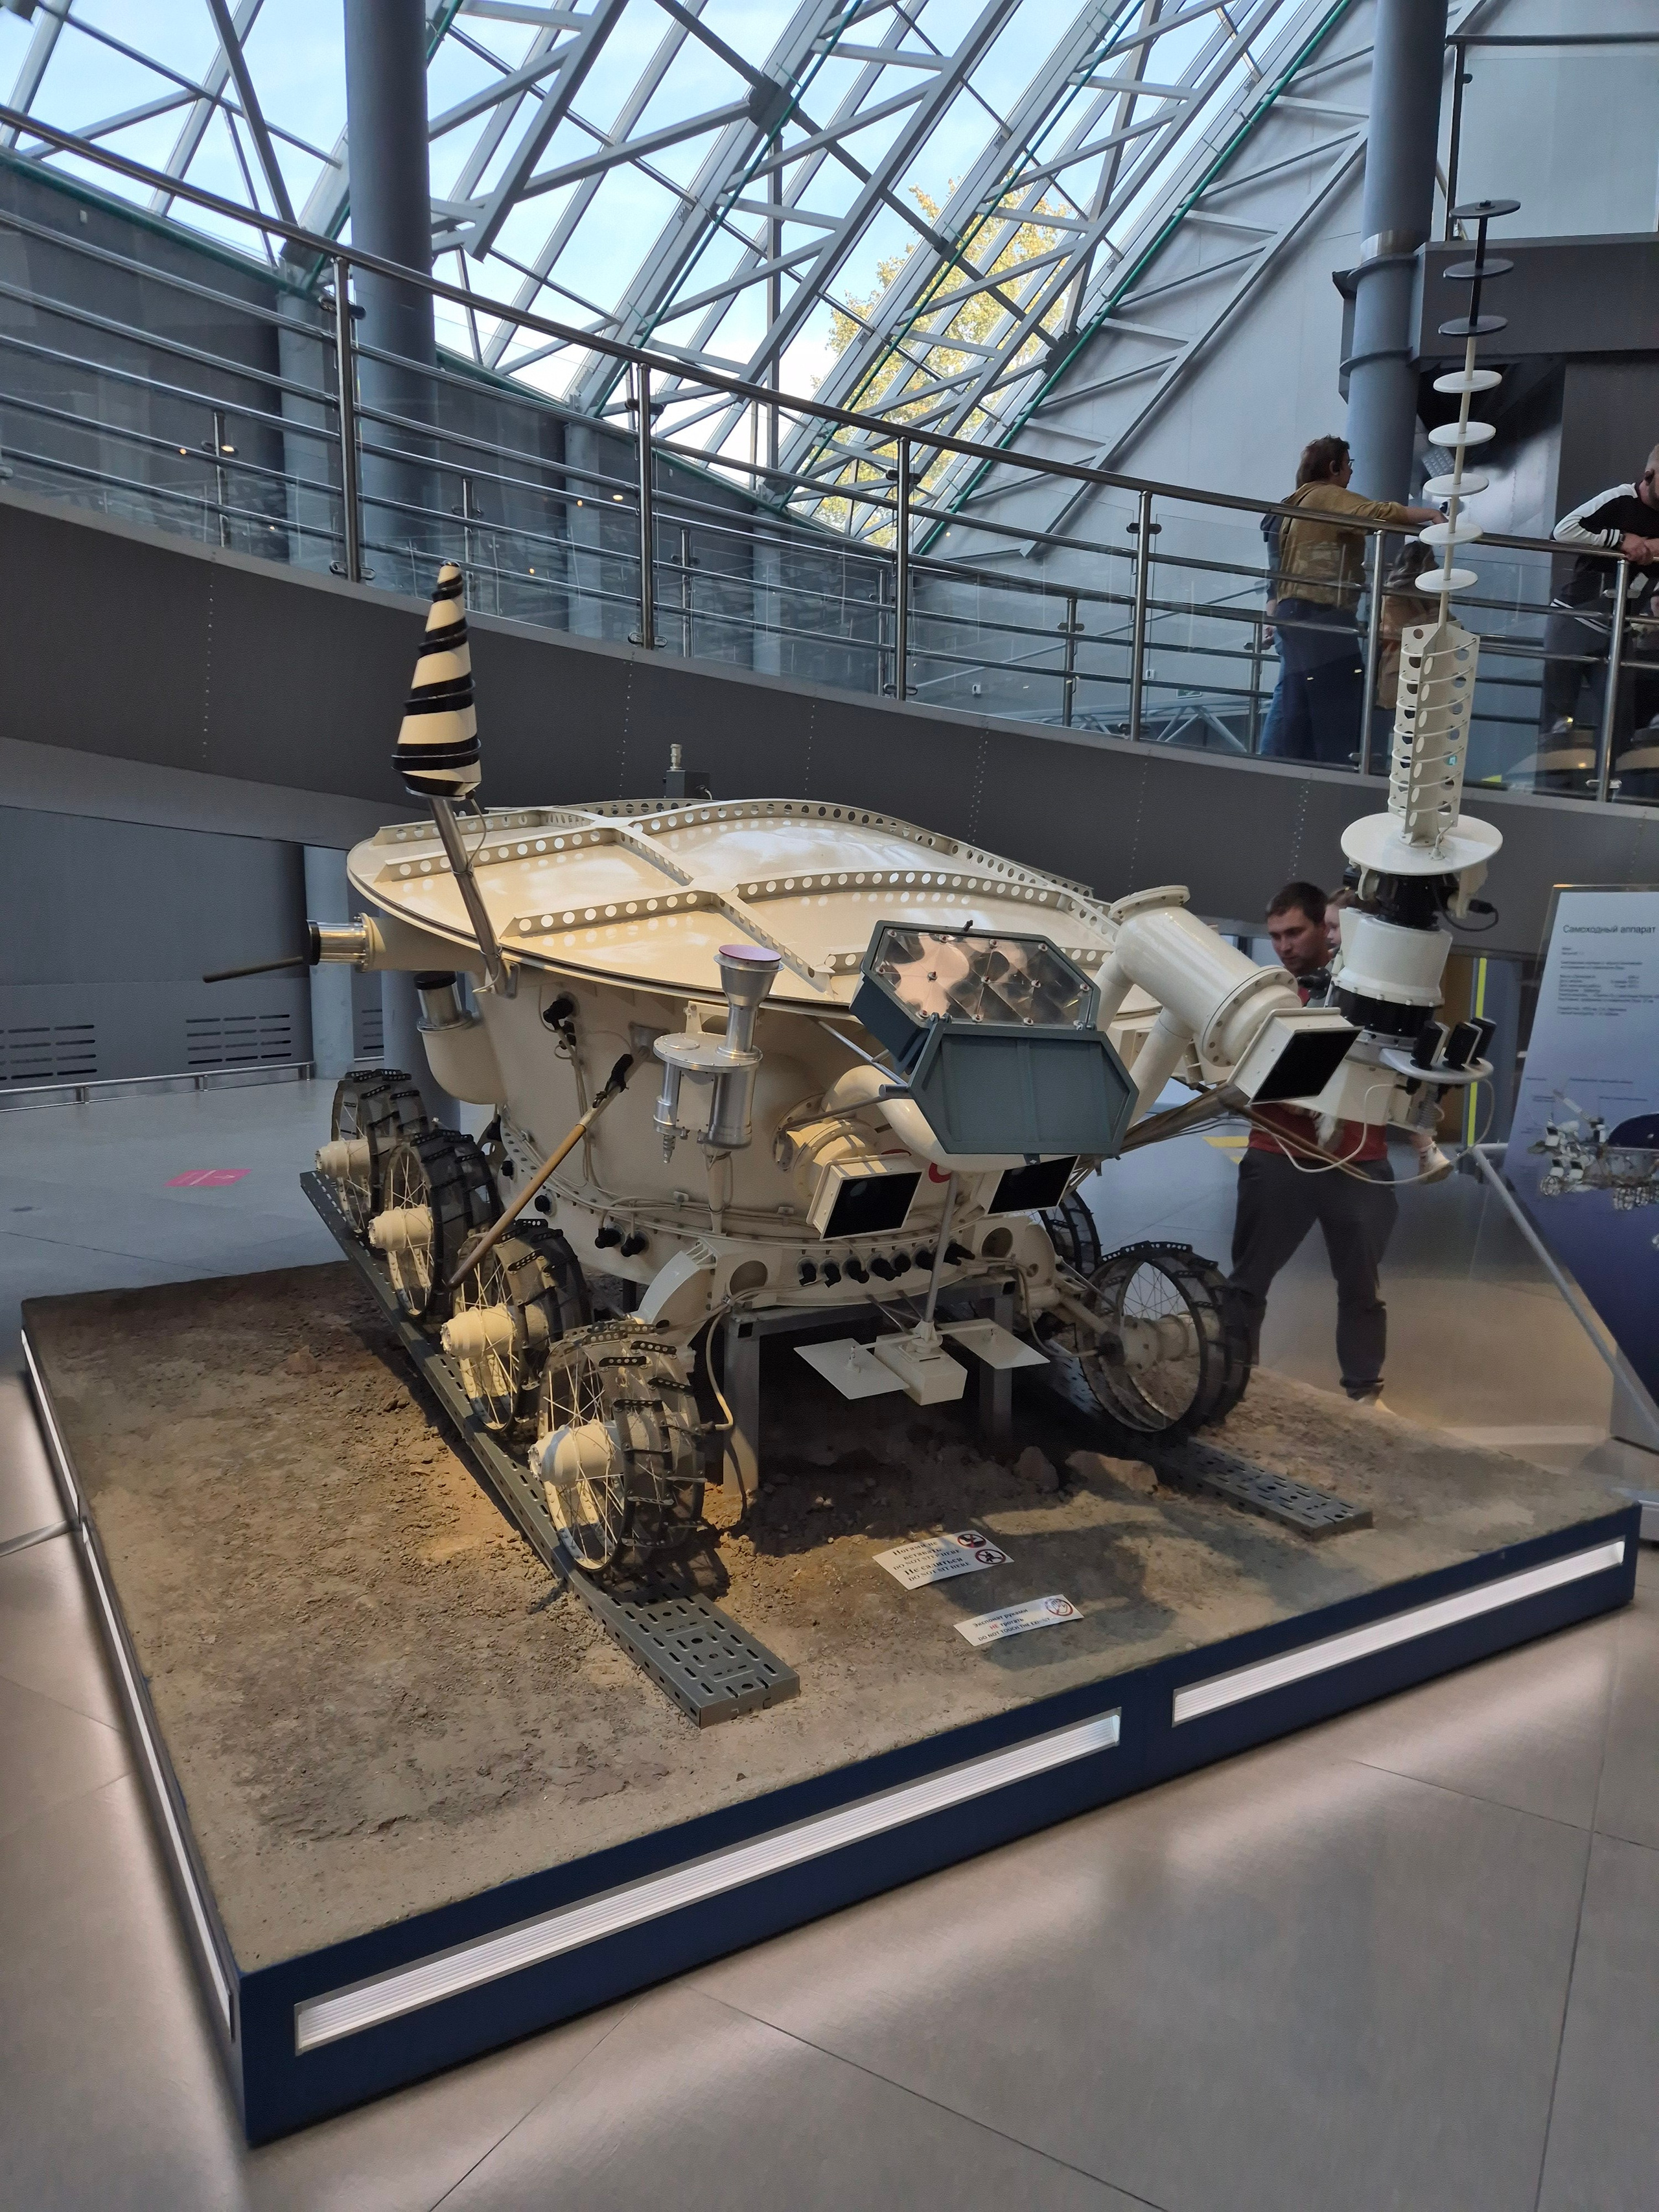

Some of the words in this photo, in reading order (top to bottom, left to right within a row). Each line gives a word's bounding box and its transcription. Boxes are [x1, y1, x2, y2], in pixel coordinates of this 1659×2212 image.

[1562, 925, 1618, 934] Самоходный
[1620, 926, 1656, 935] аппарат
[892, 1543, 926, 1555] Ногами
[903, 1548, 942, 1560] вставать
[920, 1557, 963, 1570] садиться
[973, 1615, 1003, 1628] Экспонат
[1004, 1609, 1028, 1620] руками
[1000, 1618, 1024, 1627] трогать
